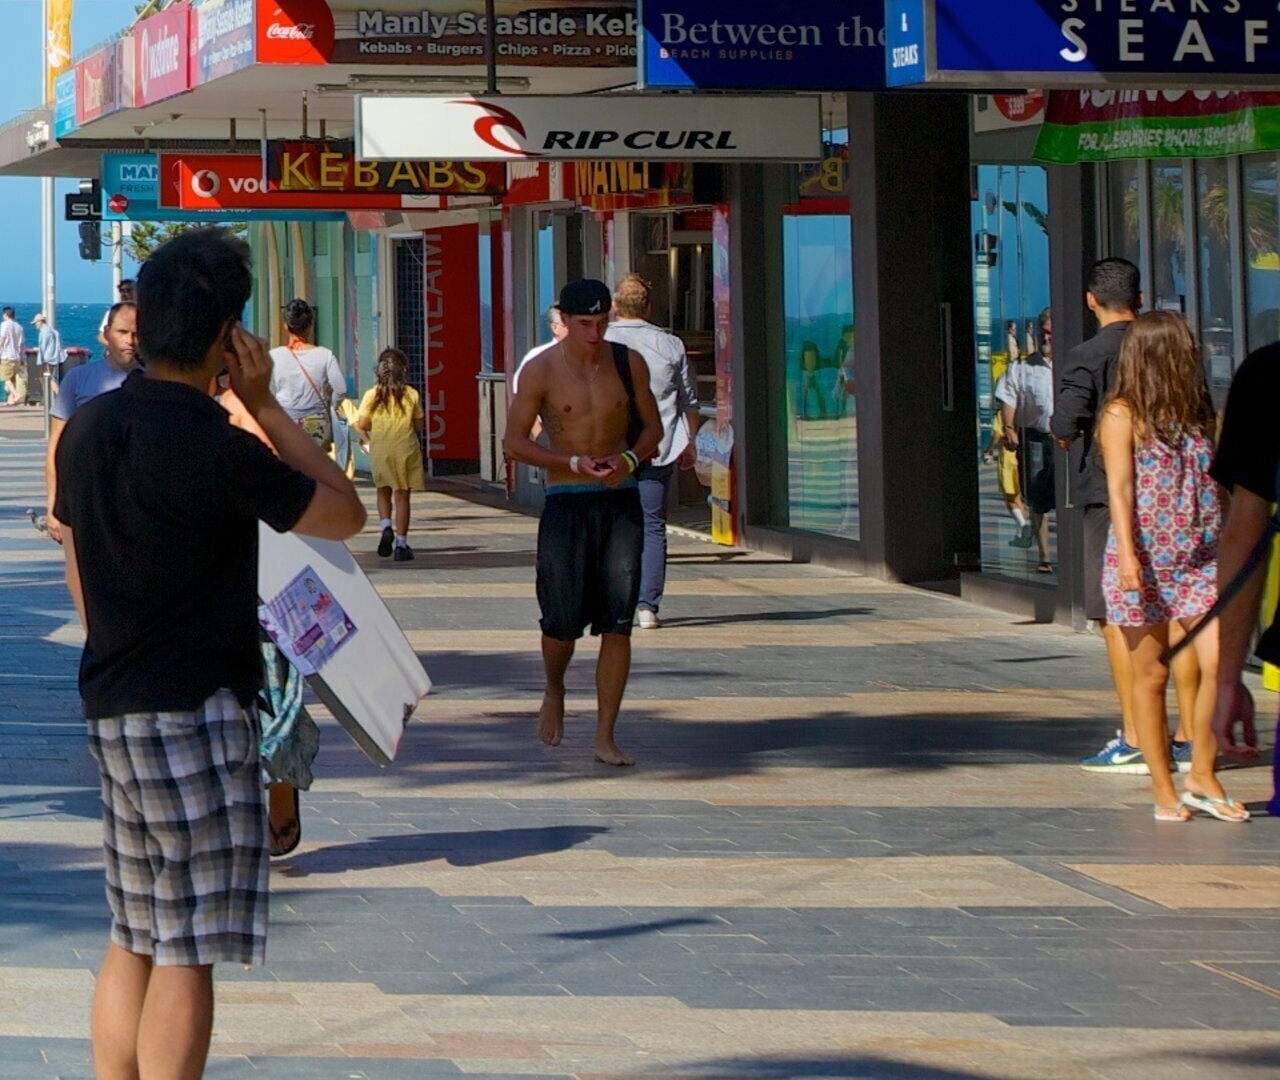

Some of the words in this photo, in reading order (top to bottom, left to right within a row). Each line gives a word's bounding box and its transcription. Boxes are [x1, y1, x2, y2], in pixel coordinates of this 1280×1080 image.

[358, 11, 448, 38] Manly
[456, 12, 576, 36] Seaside
[660, 13, 823, 46] Between
[359, 41, 412, 54] Kebabs
[427, 42, 483, 56] Burgers
[498, 43, 539, 57] Chips
[552, 44, 591, 56] Pizza
[605, 44, 638, 57] Pide
[1059, 17, 1269, 62] SEAF
[659, 47, 711, 59] BEACH
[719, 48, 794, 61] SUPPLIES
[893, 44, 919, 68] STEAKS
[542, 131, 620, 149] RIP
[623, 131, 737, 150] CURL
[282, 152, 487, 190] KEBABS
[120, 184, 155, 193] FRESH
